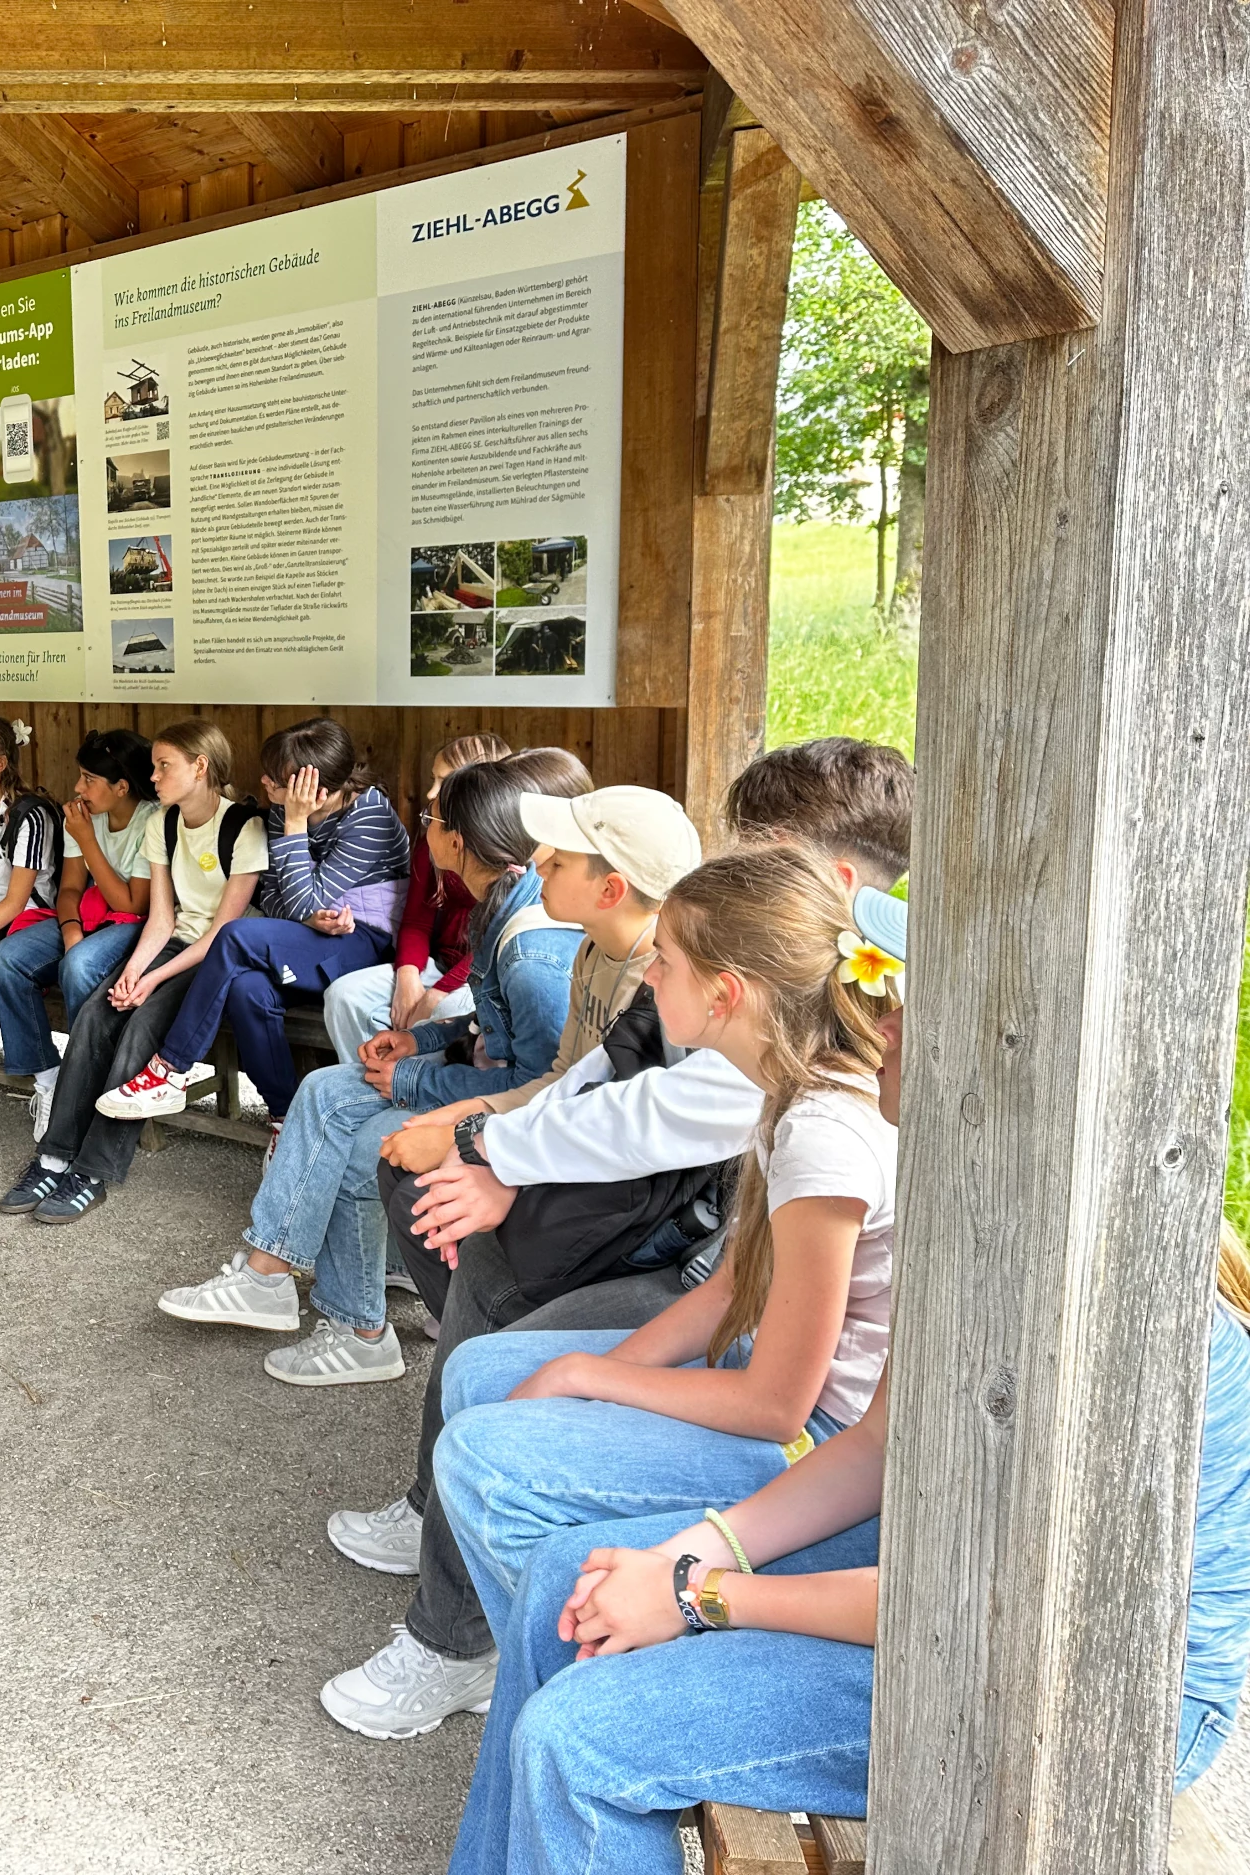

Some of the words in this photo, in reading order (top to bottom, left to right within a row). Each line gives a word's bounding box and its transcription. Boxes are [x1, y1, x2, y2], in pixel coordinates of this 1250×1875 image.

[412, 194, 560, 243] ZIEHL-ABEGG
[114, 289, 134, 306] Wie
[136, 283, 178, 302] kommen
[180, 276, 197, 292] die
[198, 262, 266, 289] historischen
[269, 248, 320, 272] Gebäude
[411, 298, 456, 312] ZIEHL-ABEGG
[564, 274, 588, 287] gehört
[18, 296, 36, 313] Sie
[114, 314, 129, 329] ins
[131, 293, 222, 326] Freilandmuseum?
[11, 385, 20, 393] iOS
[209, 468, 260, 479] TRANSLOZIERUNG
[12, 586, 22, 598] im
[25, 651, 40, 667] für
[42, 650, 66, 663] Ihren
